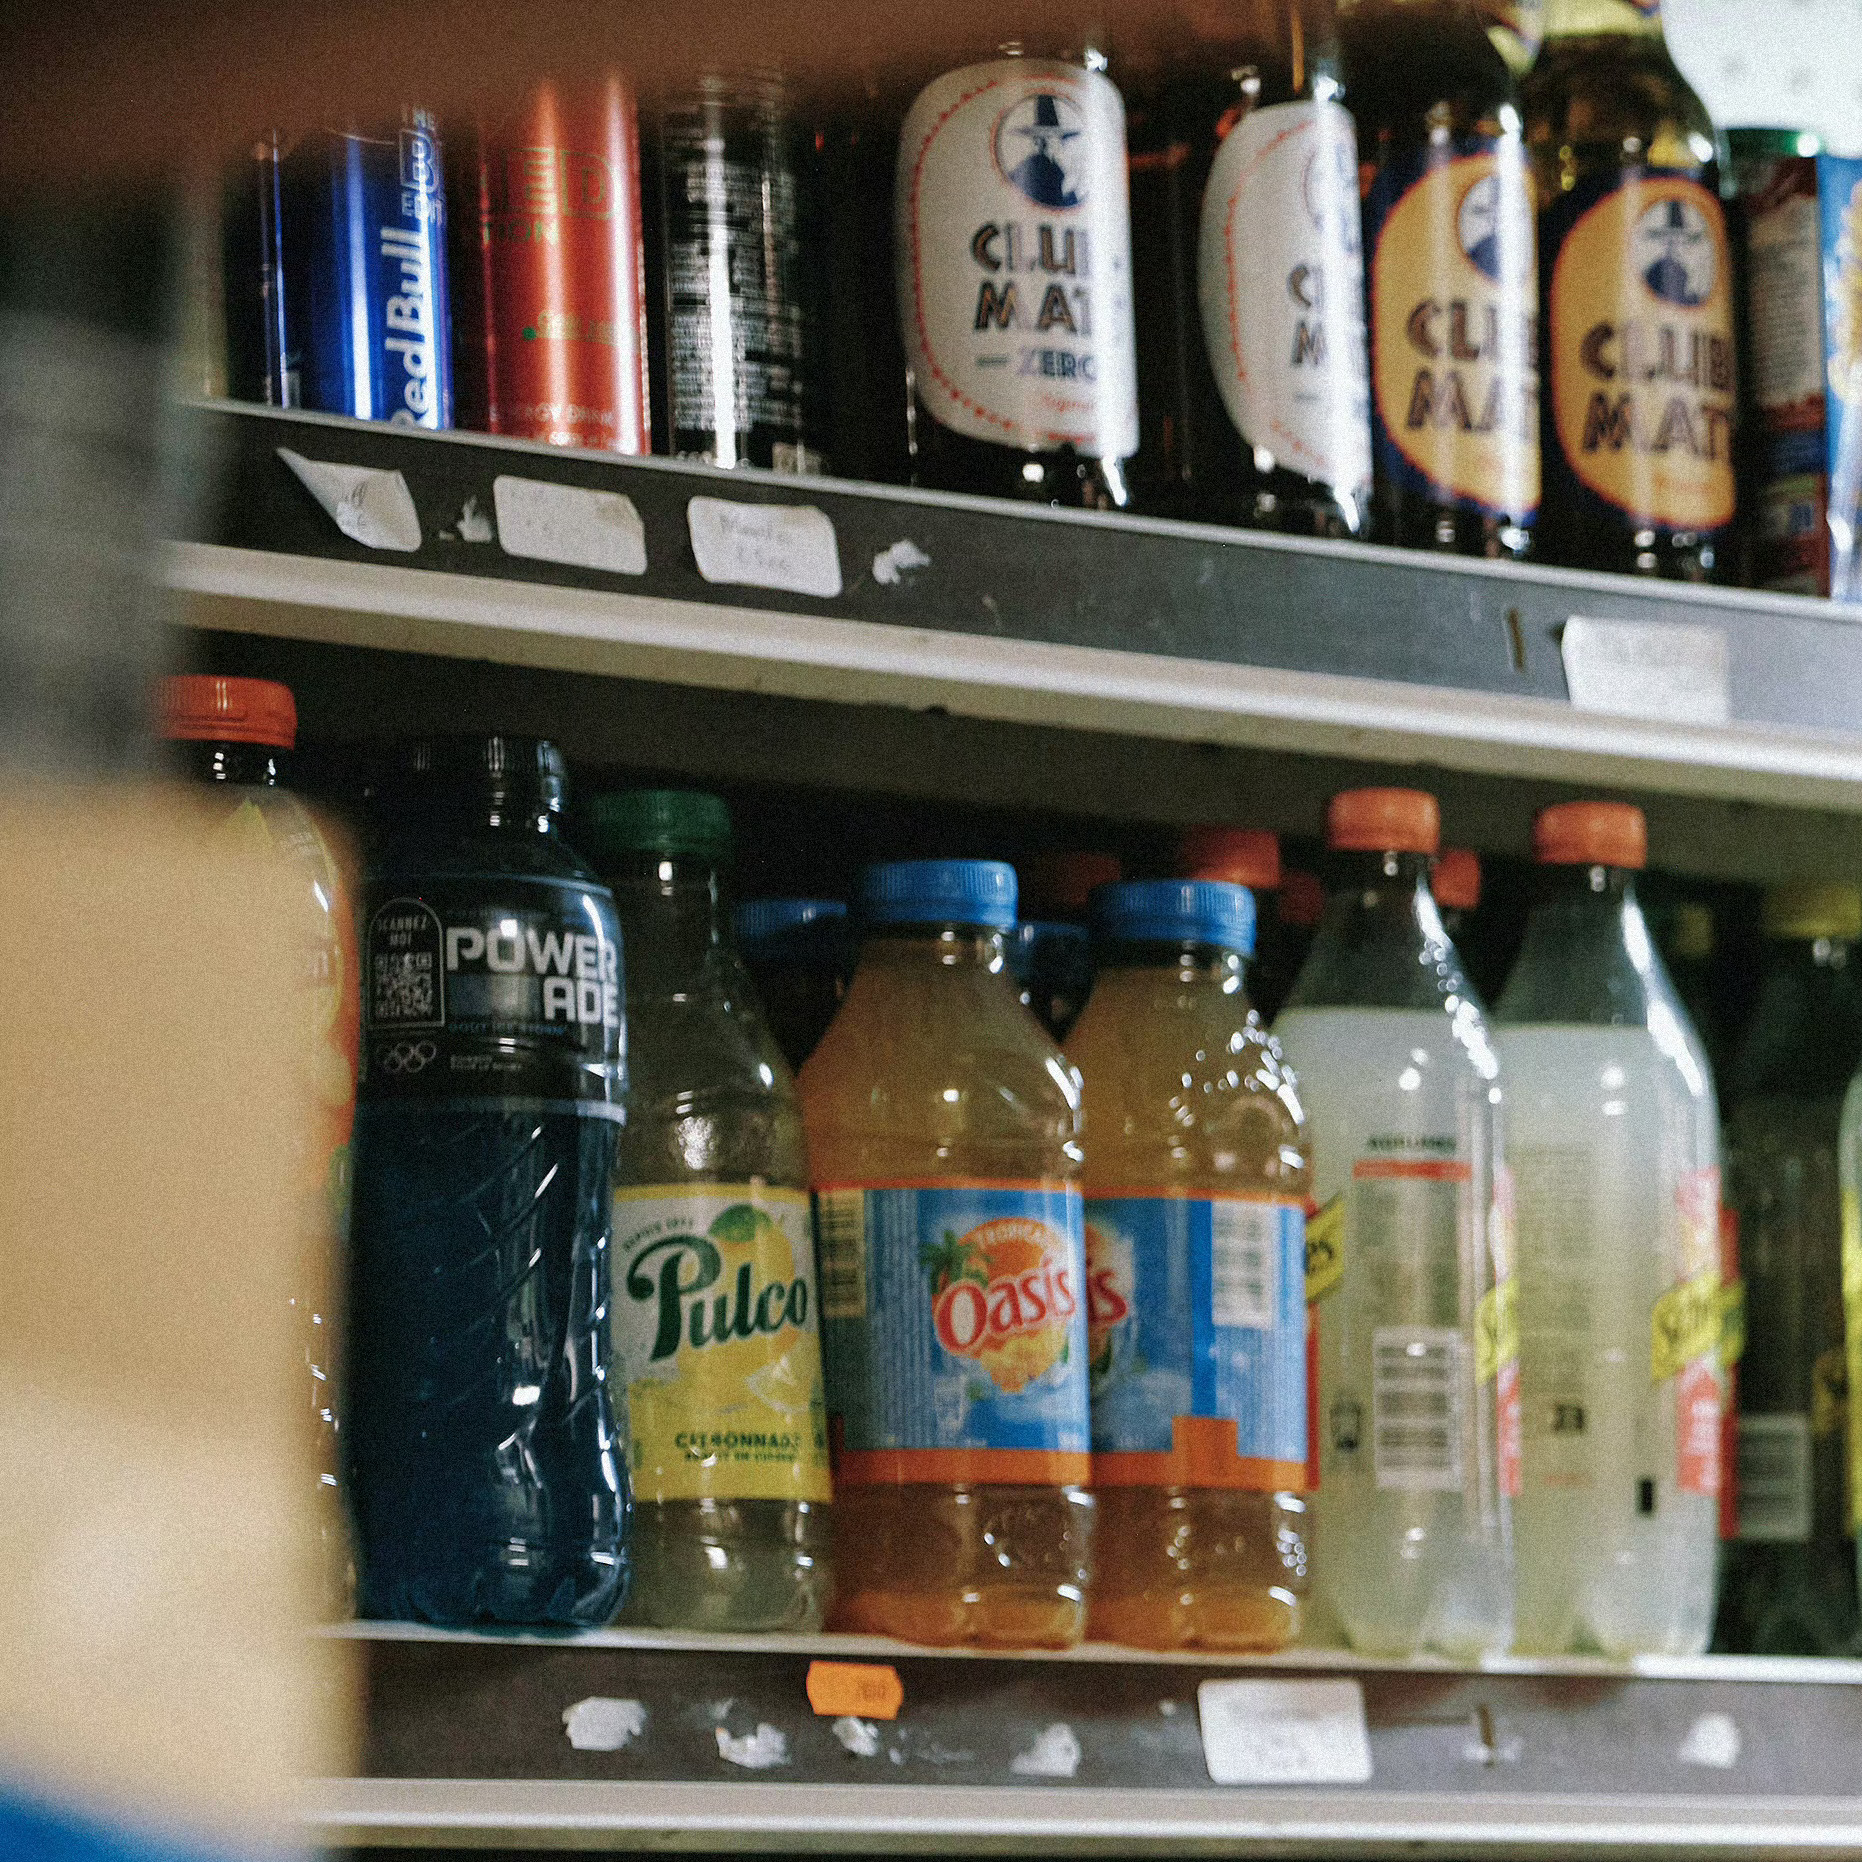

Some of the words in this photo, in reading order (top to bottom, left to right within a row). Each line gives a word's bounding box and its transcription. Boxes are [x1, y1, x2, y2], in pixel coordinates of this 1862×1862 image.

[380, 224, 430, 330] Bull
[969, 221, 1092, 276] CLU
[973, 279, 1092, 337] MAT
[1579, 320, 1738, 394] CLUB
[1582, 391, 1733, 459] MAT
[446, 926, 618, 983] POWER
[543, 975, 619, 1028] ADE
[626, 1233, 808, 1364] Pulco
[937, 1256, 1076, 1351] Oasis
